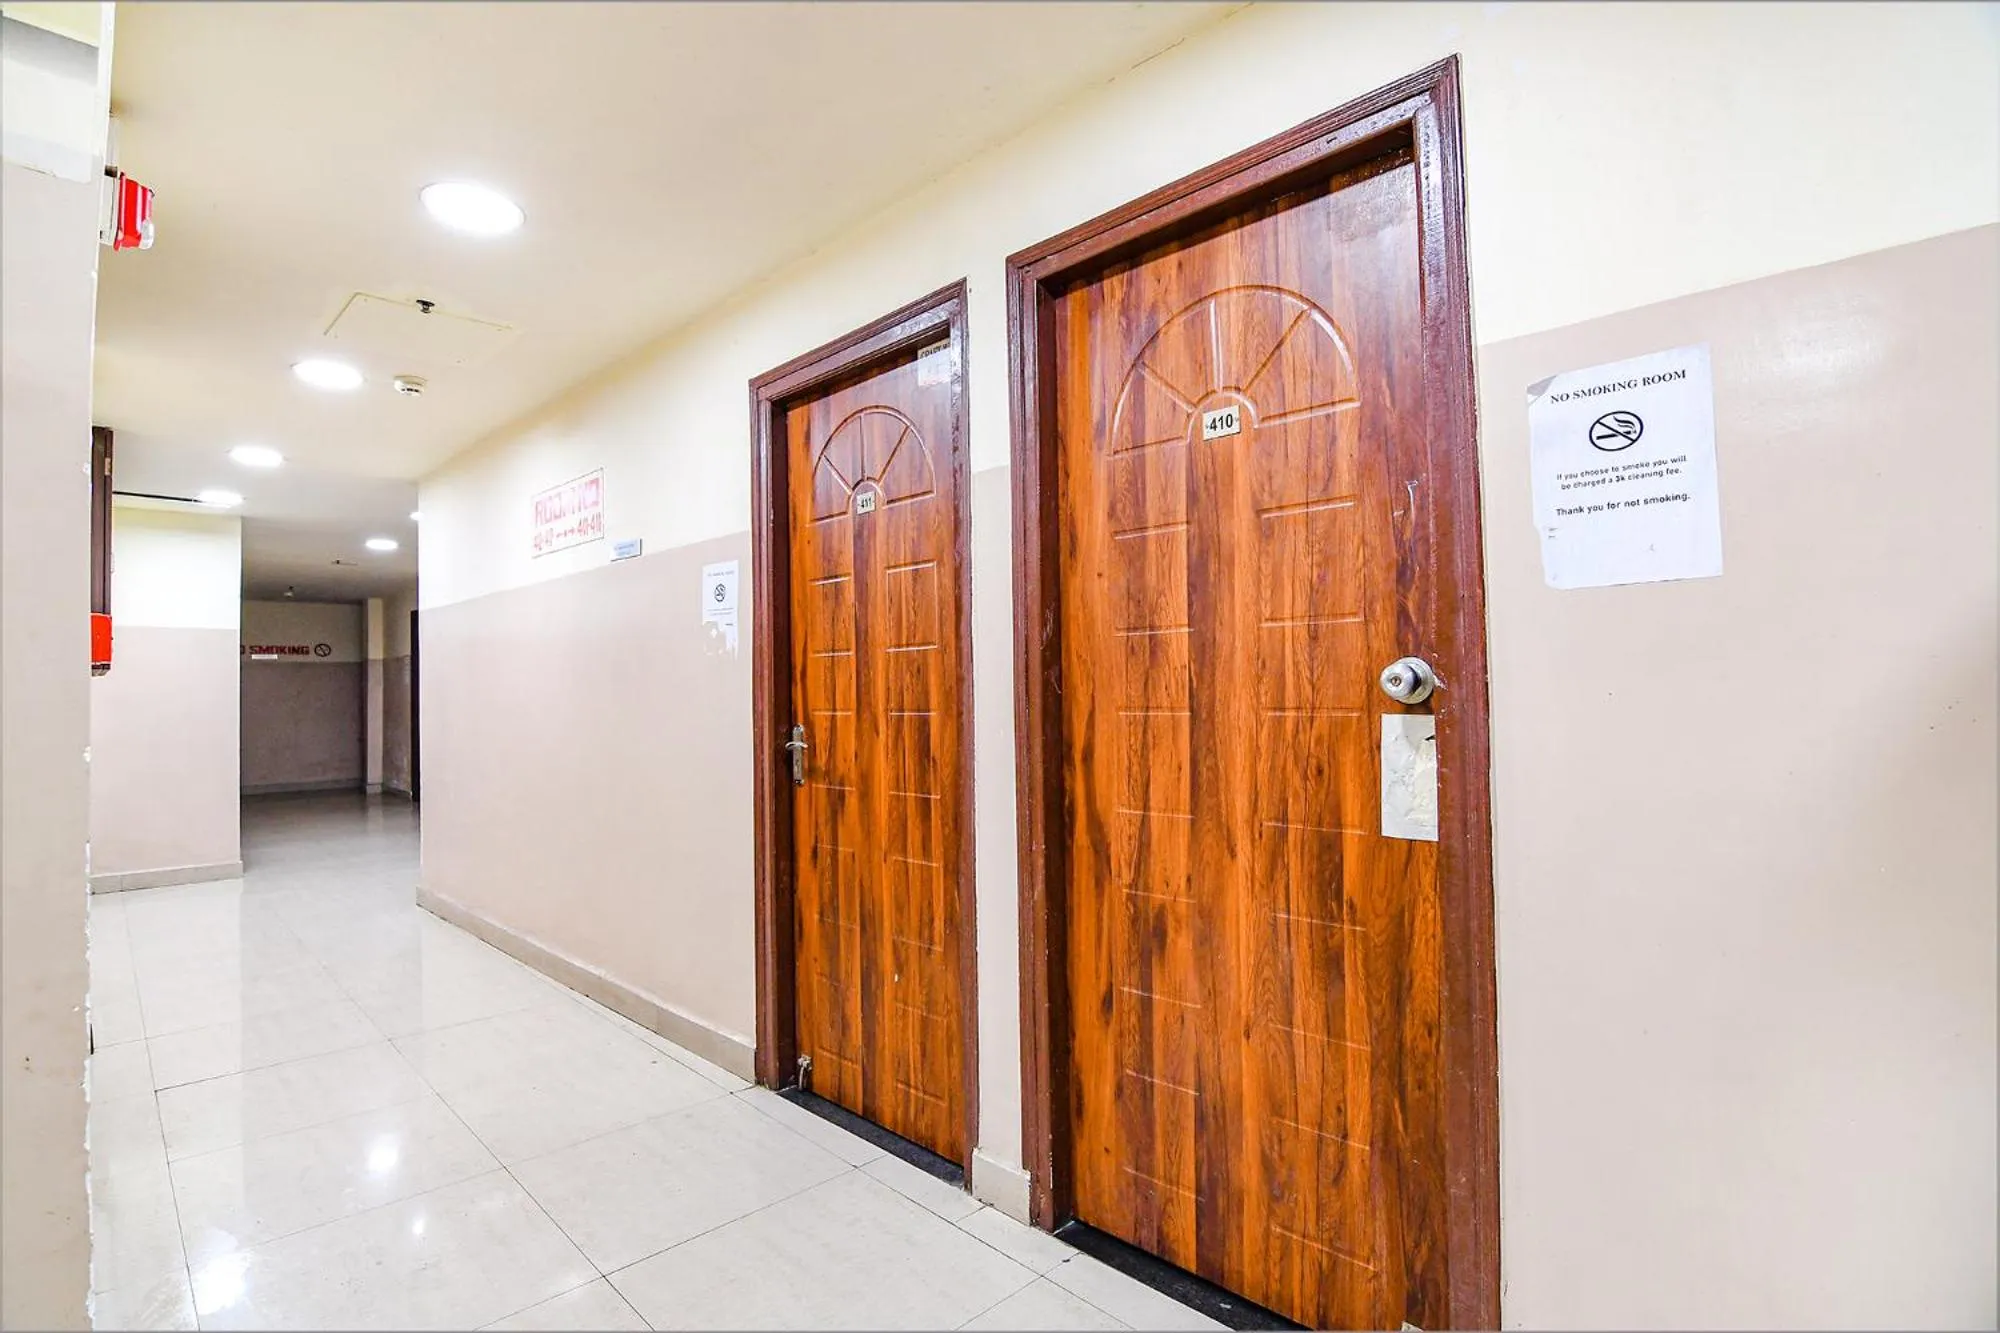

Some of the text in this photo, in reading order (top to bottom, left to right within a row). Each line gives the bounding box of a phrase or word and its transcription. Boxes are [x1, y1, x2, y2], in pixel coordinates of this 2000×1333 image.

[1551, 369, 1687, 404] NO SMOKING ROOM
[1209, 413, 1234, 431] 410
[1561, 482, 1571, 490] be
[1573, 477, 1606, 489] charged
[1615, 474, 1626, 483] 3k
[1628, 469, 1664, 481] cleaning
[1665, 467, 1682, 476] fee.
[1564, 471, 1578, 481] you
[1580, 467, 1609, 477] choose
[1611, 465, 1620, 473] to
[1622, 461, 1650, 471] smoke
[1652, 459, 1668, 468] you
[1670, 455, 1687, 463] will
[1556, 492, 1691, 516] Thank you for not smoking.
[248, 645, 310, 655] SMOKING
